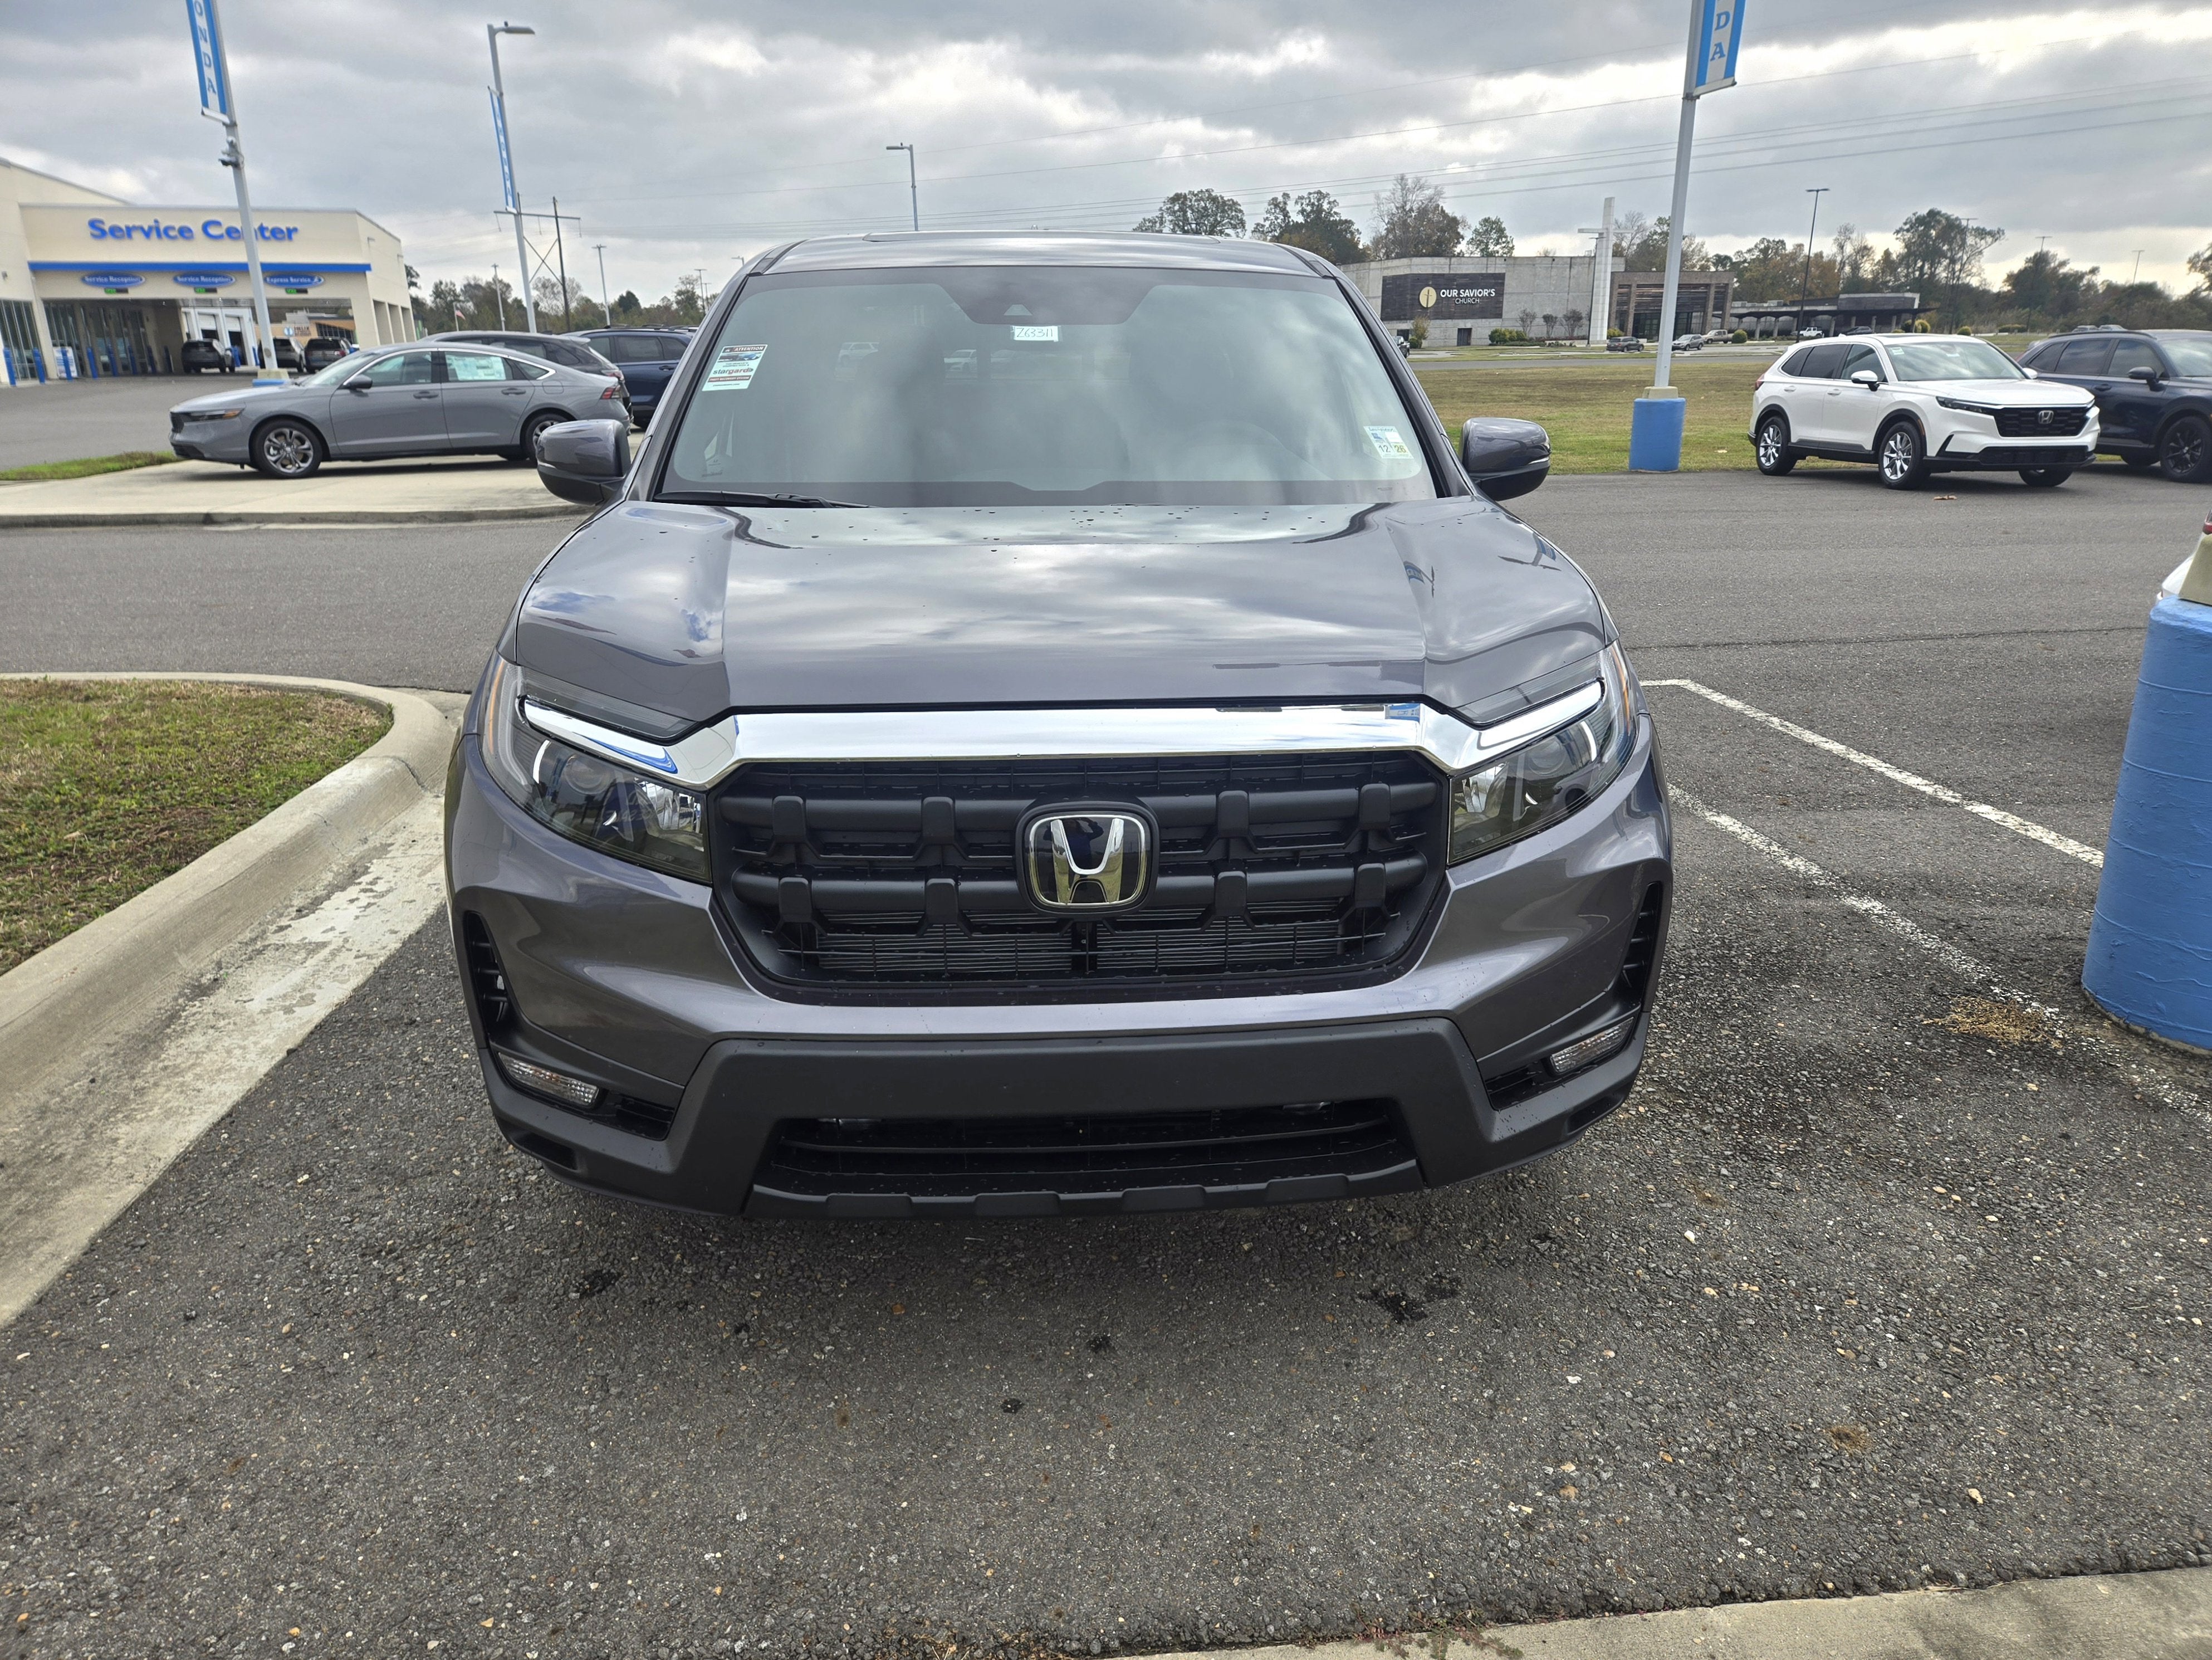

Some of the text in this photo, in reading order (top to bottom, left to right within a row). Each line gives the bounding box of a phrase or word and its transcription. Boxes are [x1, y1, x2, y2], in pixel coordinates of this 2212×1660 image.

[1710, 0, 1730, 61] DA
[87, 218, 194, 240] Service
[1440, 289, 1496, 297] OUR SAVIOR'S
[1378, 445, 1407, 453] 12 26
